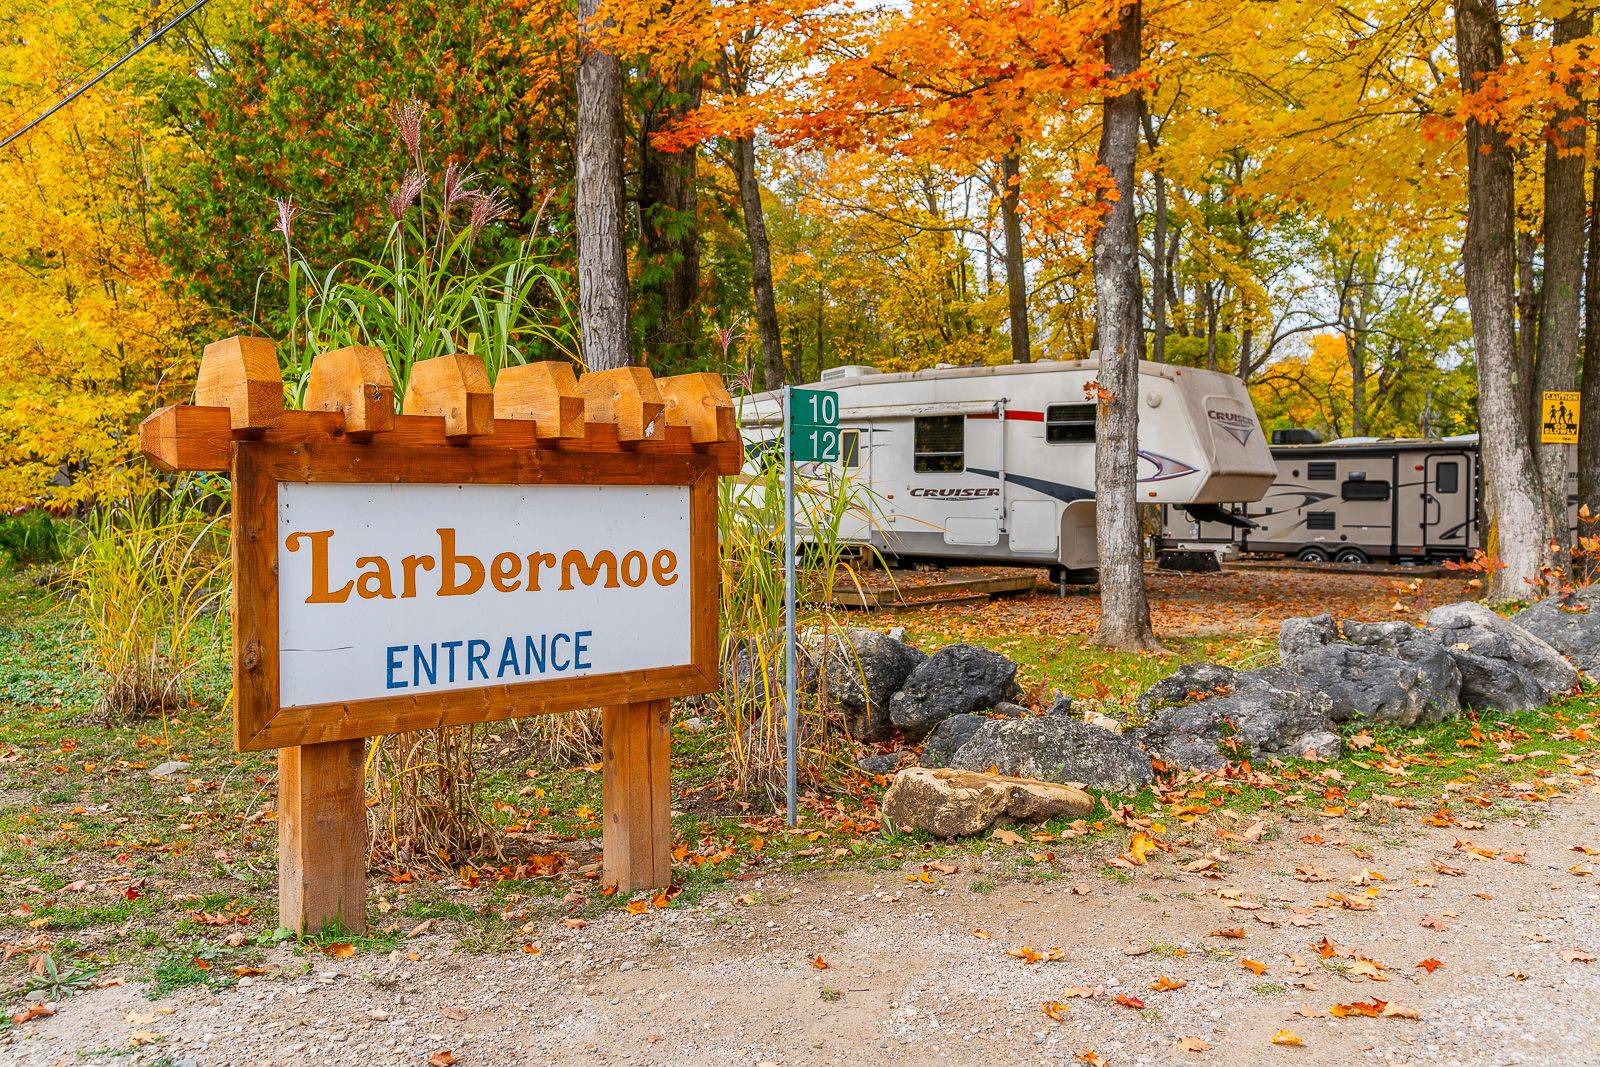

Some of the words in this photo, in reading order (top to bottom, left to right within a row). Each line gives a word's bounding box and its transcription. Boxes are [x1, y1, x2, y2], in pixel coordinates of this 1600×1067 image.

[808, 394, 836, 425] 10
[1207, 410, 1255, 426] CRUISER
[808, 430, 836, 460] 12
[909, 487, 1000, 497] CRUISER
[285, 528, 679, 604] Larbermoe
[386, 630, 593, 690] ENTRANCE
